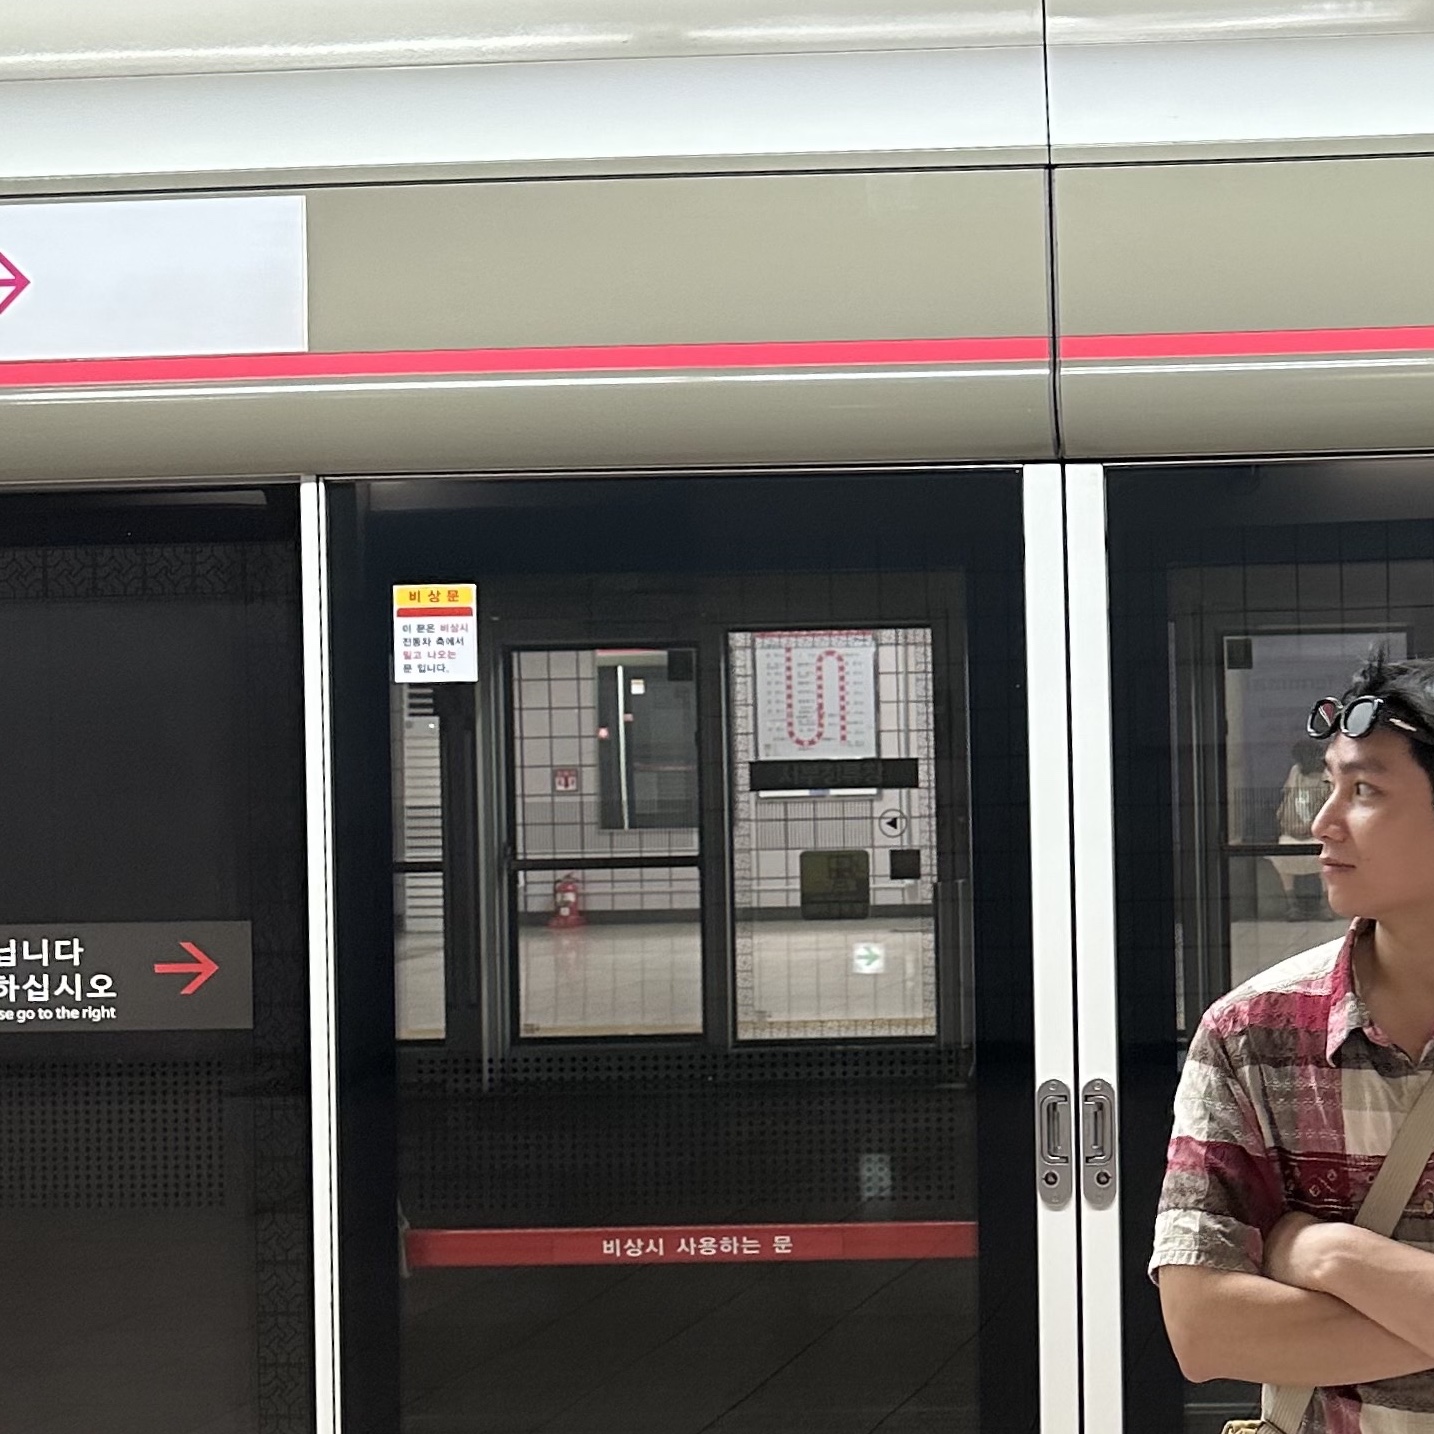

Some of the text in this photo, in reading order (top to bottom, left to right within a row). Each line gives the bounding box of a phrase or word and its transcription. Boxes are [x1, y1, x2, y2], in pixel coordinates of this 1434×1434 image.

[408, 590, 460, 603] 비상문
[402, 624, 412, 634] 이
[440, 623, 469, 633] 비상시
[402, 650, 457, 661] 밀고 나오는
[402, 663, 413, 674] 문
[16, 1009, 36, 1024] go
[37, 1007, 54, 1020] to
[55, 1006, 80, 1020] the
[81, 1005, 117, 1022] right
[602, 1235, 794, 1258] 비상시 사용하는 문
